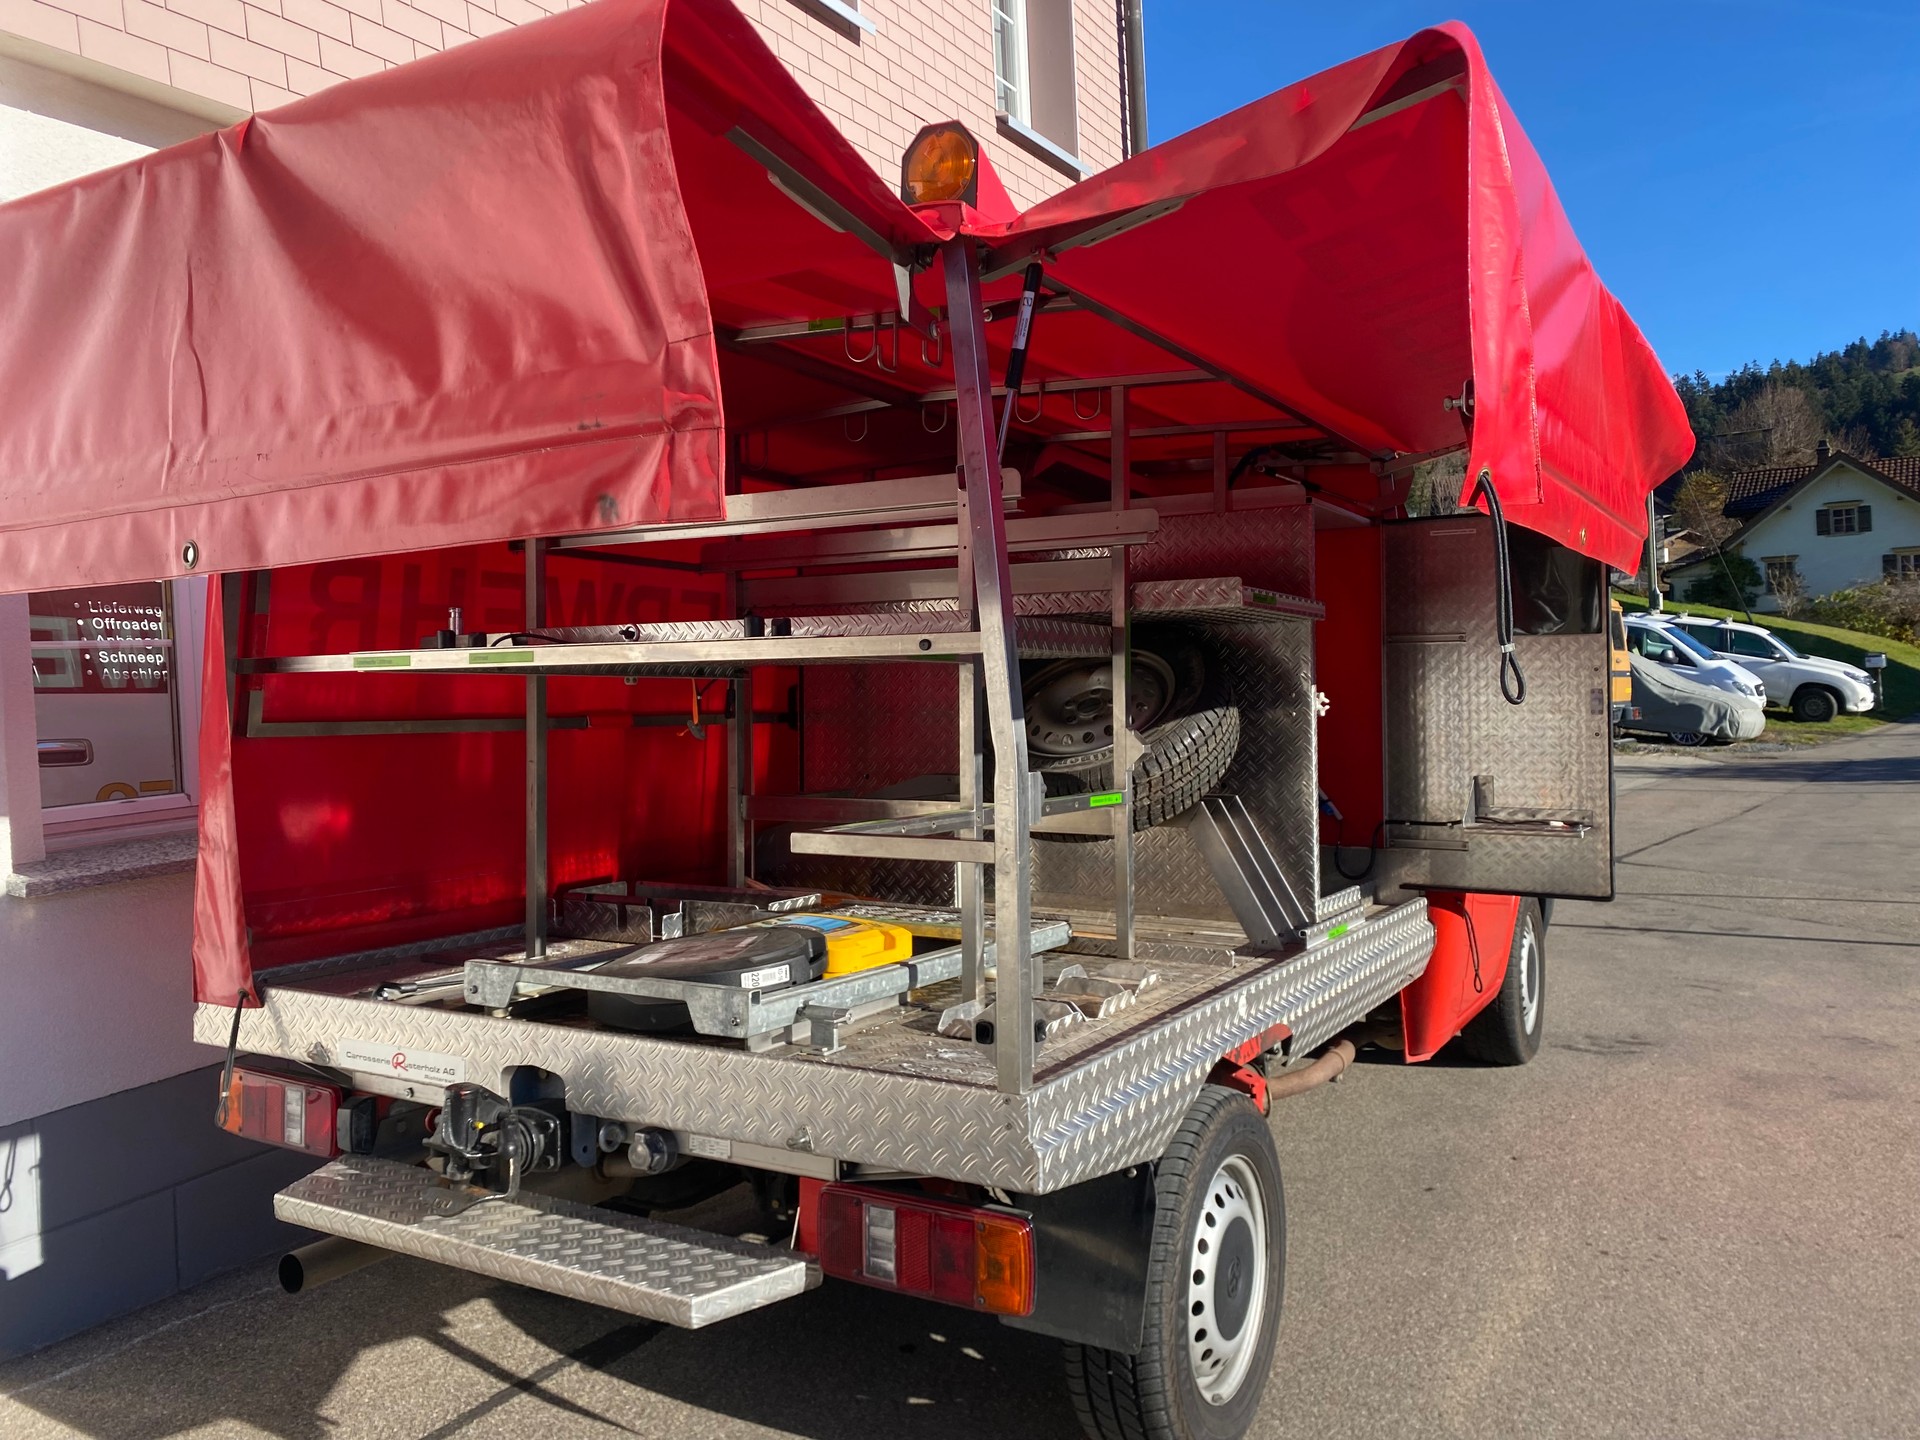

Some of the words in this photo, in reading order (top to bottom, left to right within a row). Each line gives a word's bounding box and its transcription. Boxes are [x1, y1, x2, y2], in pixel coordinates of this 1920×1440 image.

[99, 651, 163, 666] Schneep
[751, 972, 760, 987] 220
[345, 1051, 391, 1066] Carrosserie
[442, 1067, 456, 1076] AG
